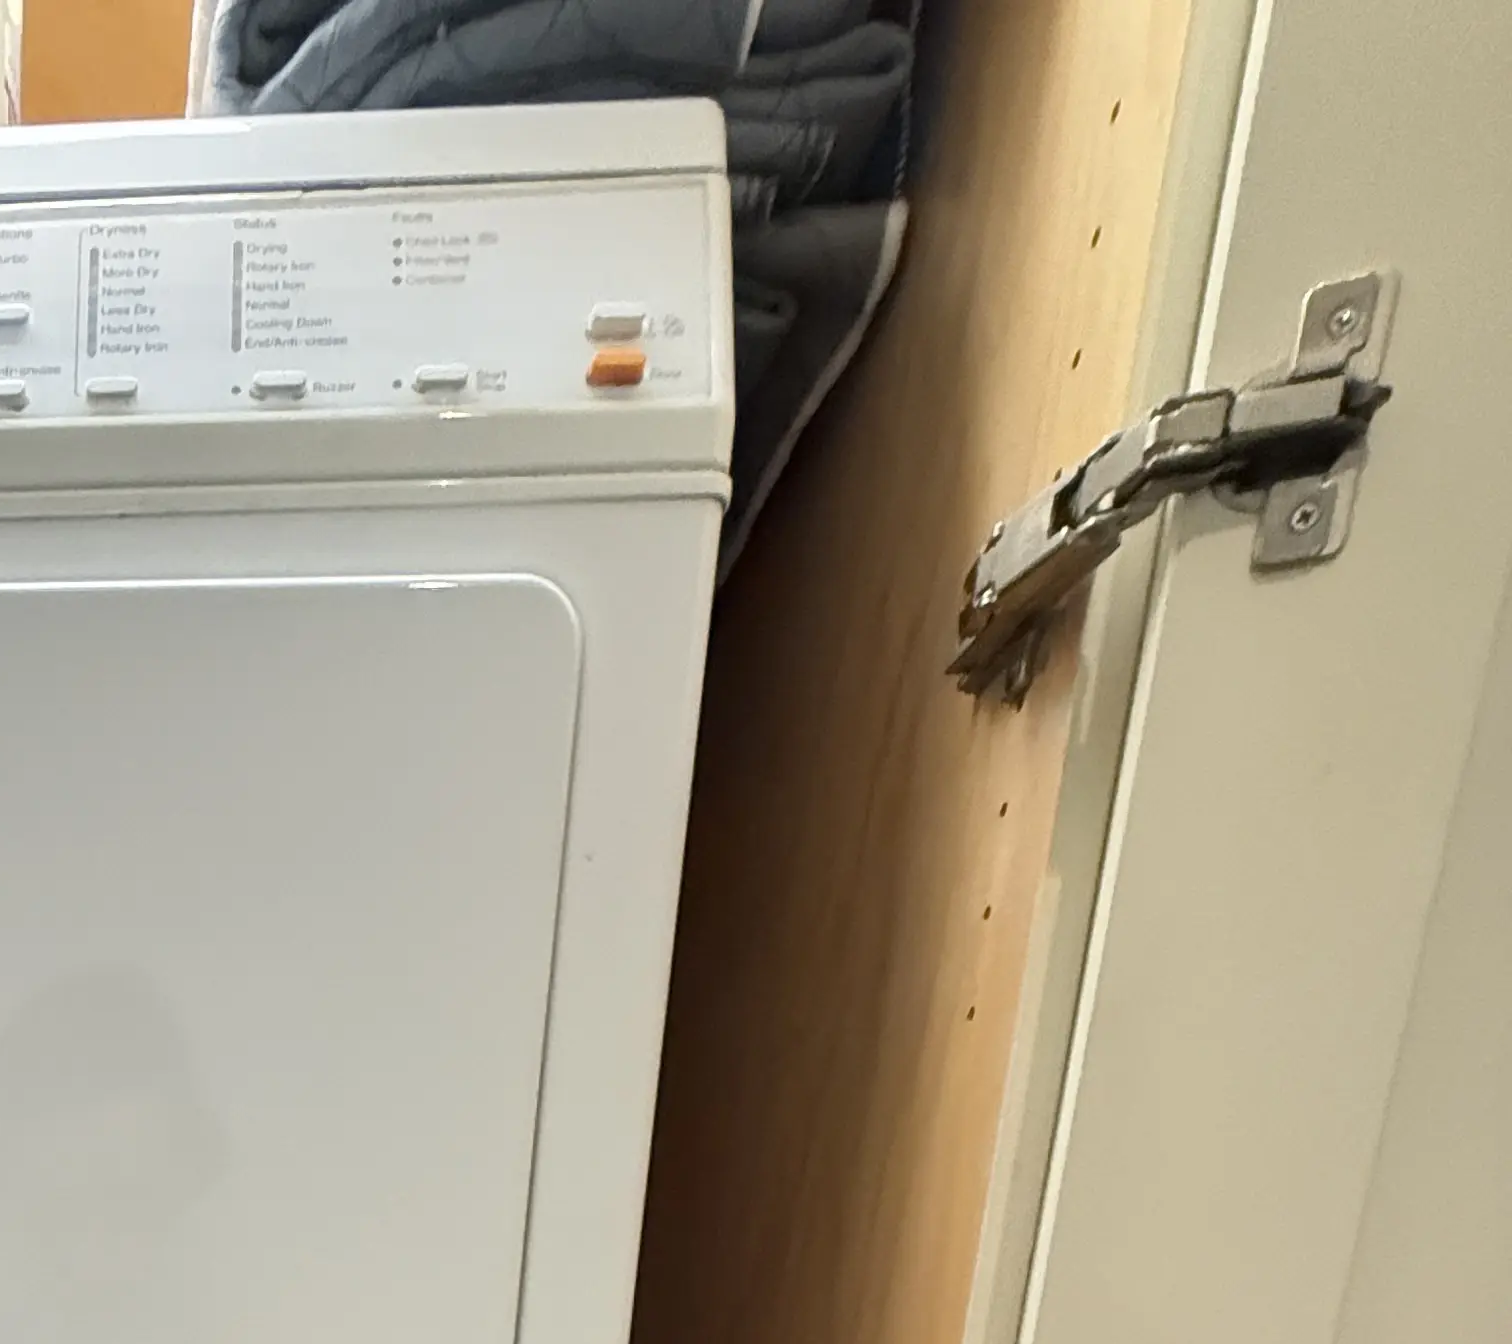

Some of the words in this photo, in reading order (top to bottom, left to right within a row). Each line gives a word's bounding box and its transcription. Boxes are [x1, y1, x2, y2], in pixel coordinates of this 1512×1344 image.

[138, 248, 160, 259] Dry
[138, 267, 159, 279] Dry
[134, 304, 156, 316] Dry
